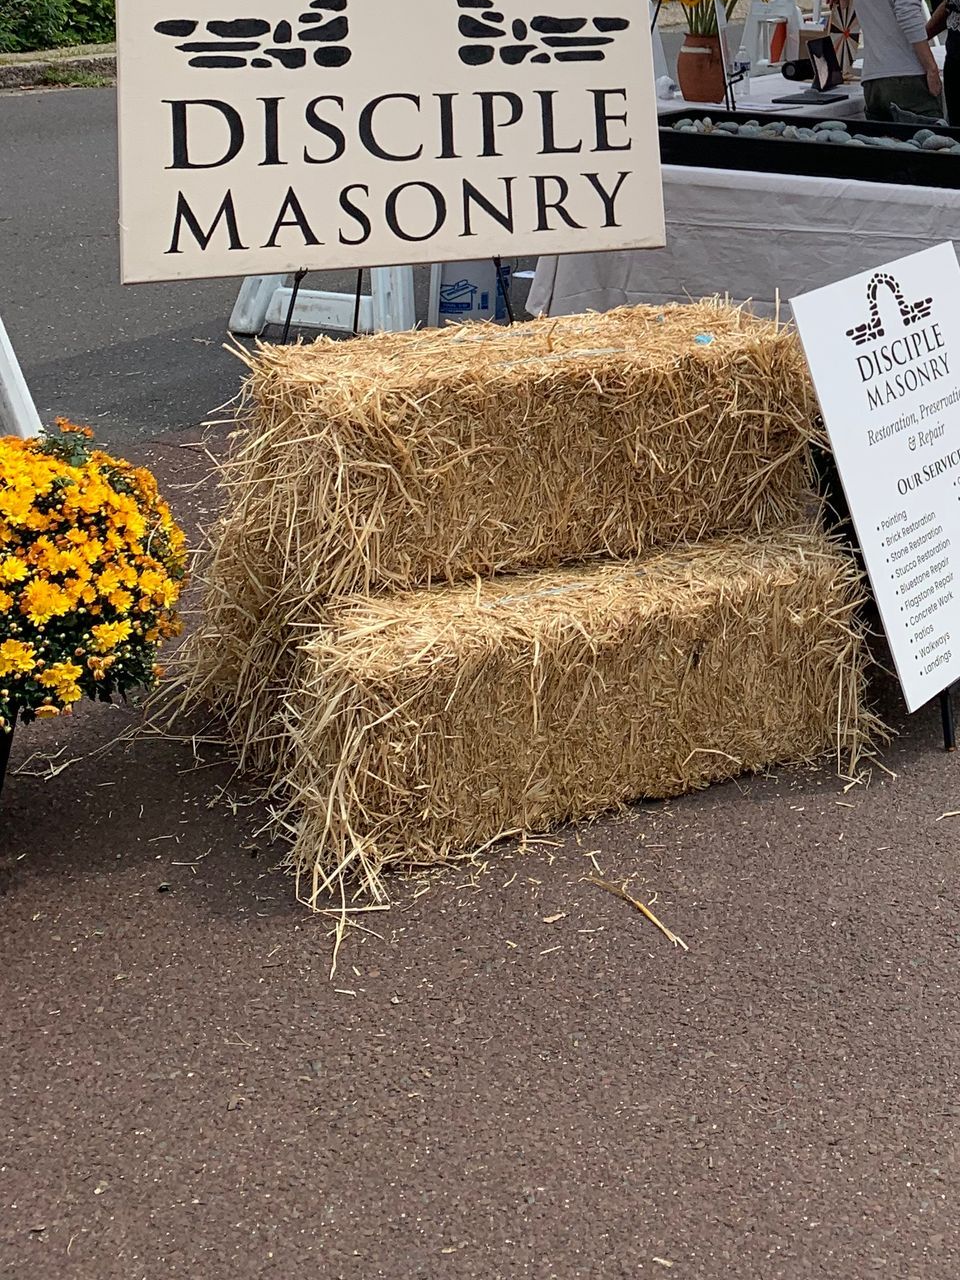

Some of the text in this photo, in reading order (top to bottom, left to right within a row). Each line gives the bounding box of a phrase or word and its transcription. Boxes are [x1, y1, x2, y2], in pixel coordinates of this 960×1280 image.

[161, 87, 632, 170] DISCIPLE
[163, 171, 632, 255] MASONRY
[856, 323, 944, 382] DISCIPLE
[866, 352, 950, 410] MASONRY
[868, 413, 919, 446] Restoration,
[908, 421, 945, 451] & Repair
[881, 510, 907, 530] Pointing
[886, 512, 936, 546] Brick Restoration
[890, 525, 943, 562] Stone Restoration
[895, 539, 951, 578] Stucco Restoration
[900, 556, 949, 594] Bluestone Repair
[905, 572, 953, 610] Flagstone Repair
[910, 591, 954, 626] Concrete Work
[914, 624, 934, 642] Patios
[919, 632, 951, 658] Walkways
[924, 650, 952, 675] Landings
